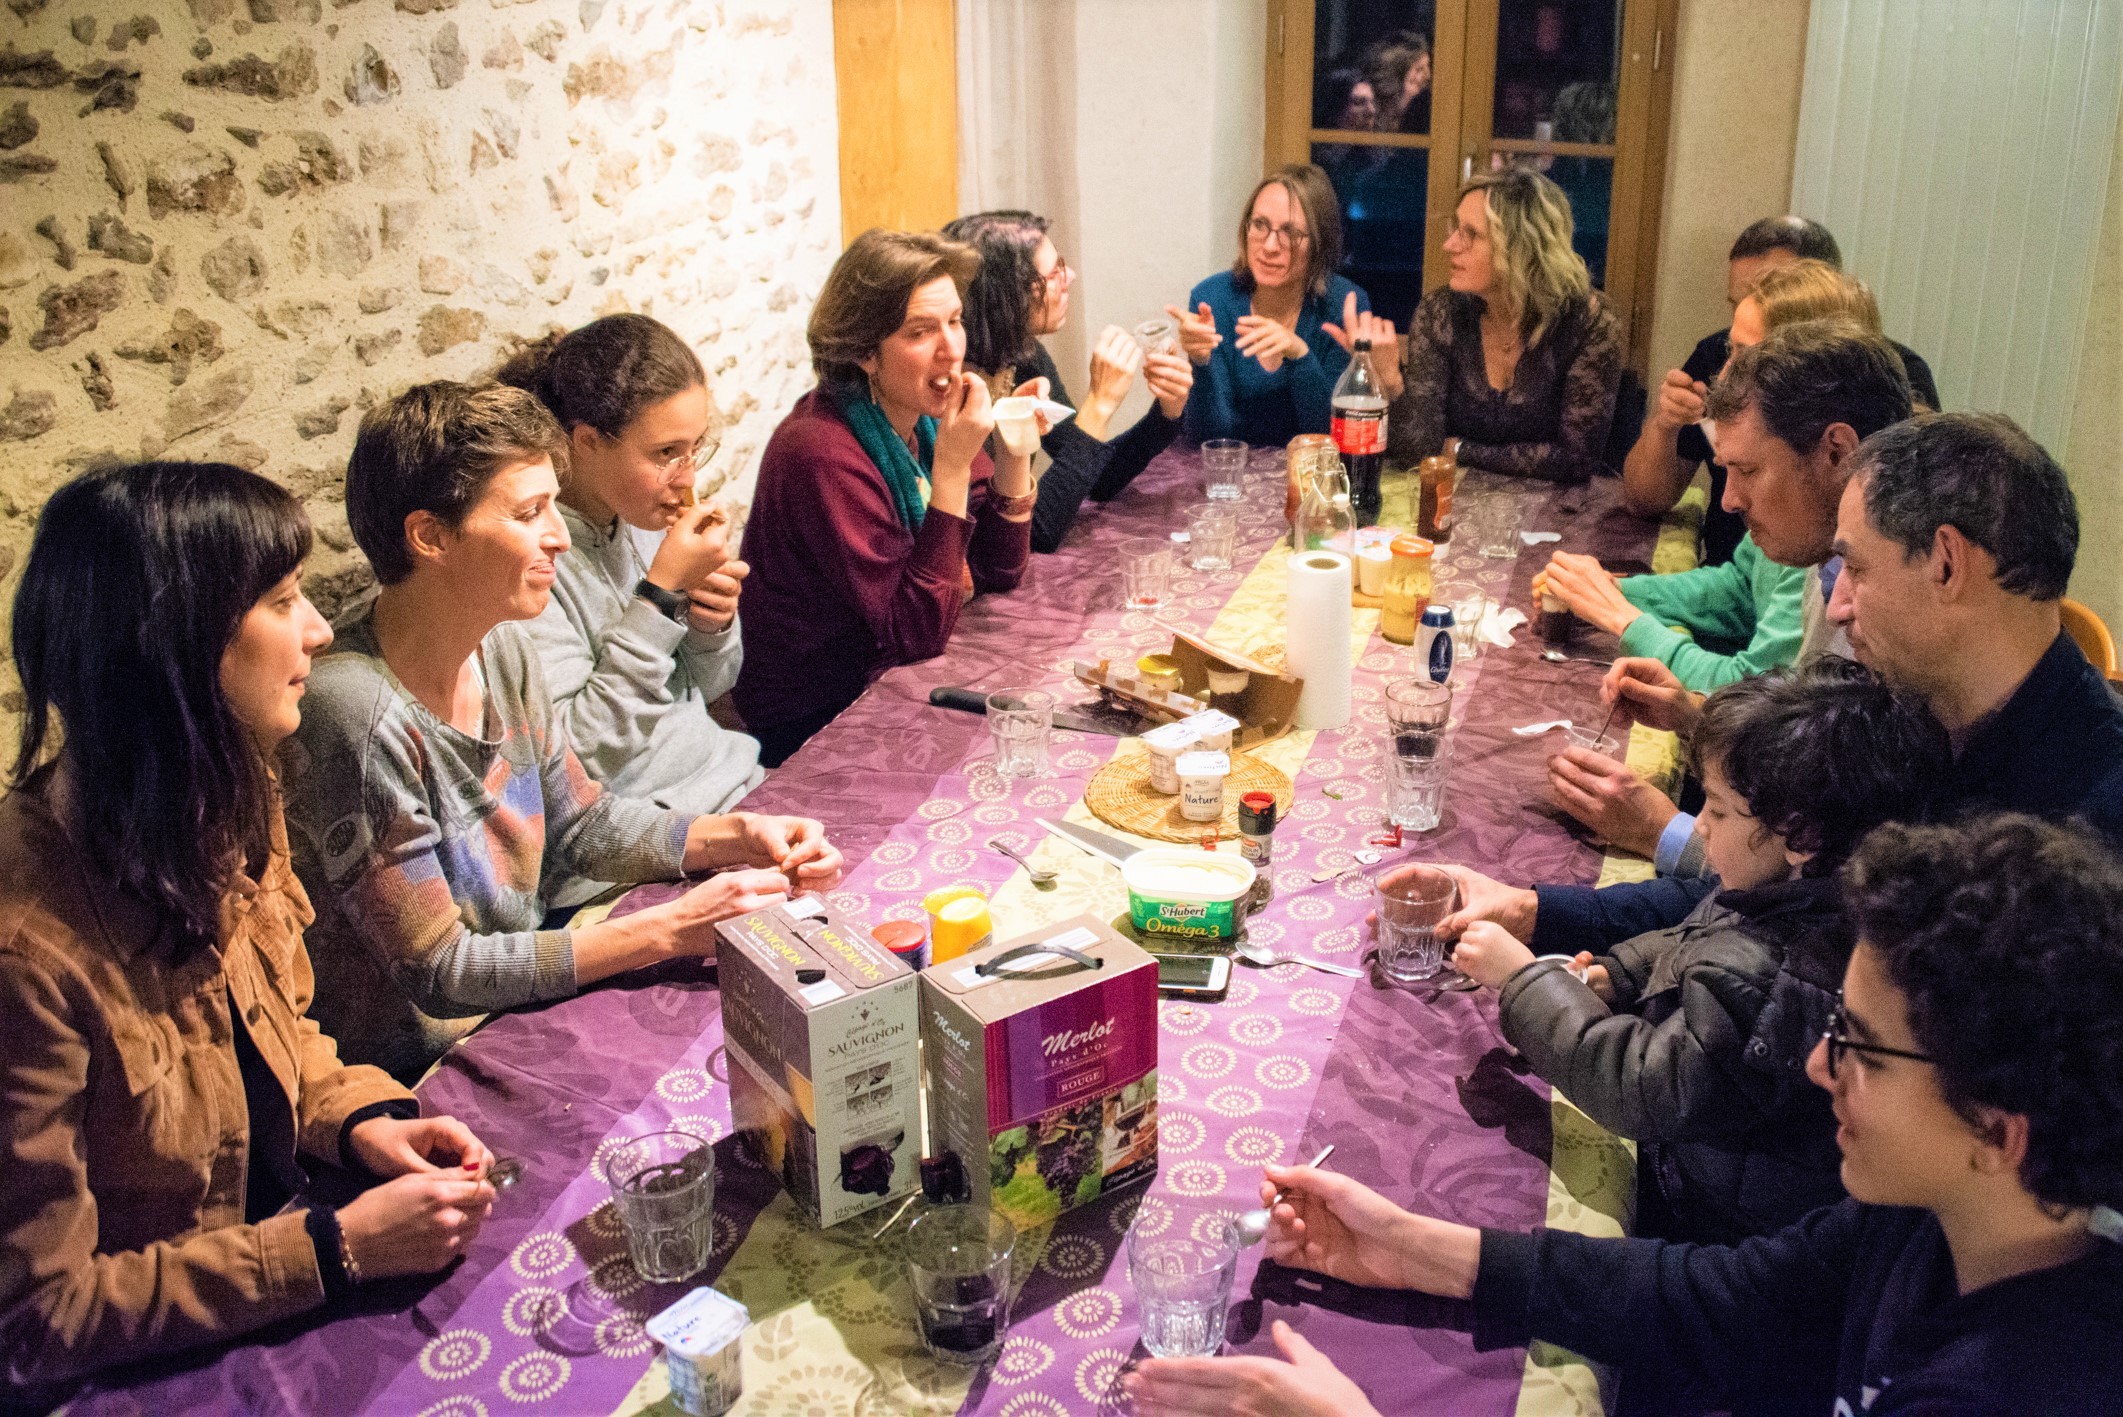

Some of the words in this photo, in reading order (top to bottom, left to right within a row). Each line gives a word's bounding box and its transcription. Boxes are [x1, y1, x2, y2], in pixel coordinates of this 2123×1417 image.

[1184, 793, 1219, 805] Nature
[744, 917, 806, 966] SAUVIGNON
[1146, 917, 1208, 938] Oméga
[1208, 925, 1220, 938] 3
[818, 930, 885, 980] SAUVIGNON
[828, 1022, 905, 1057] SAUVIGNON
[933, 1011, 971, 1051] Merlot
[1042, 1016, 1115, 1057] Merlot
[1061, 1071, 1100, 1092] ROUGE
